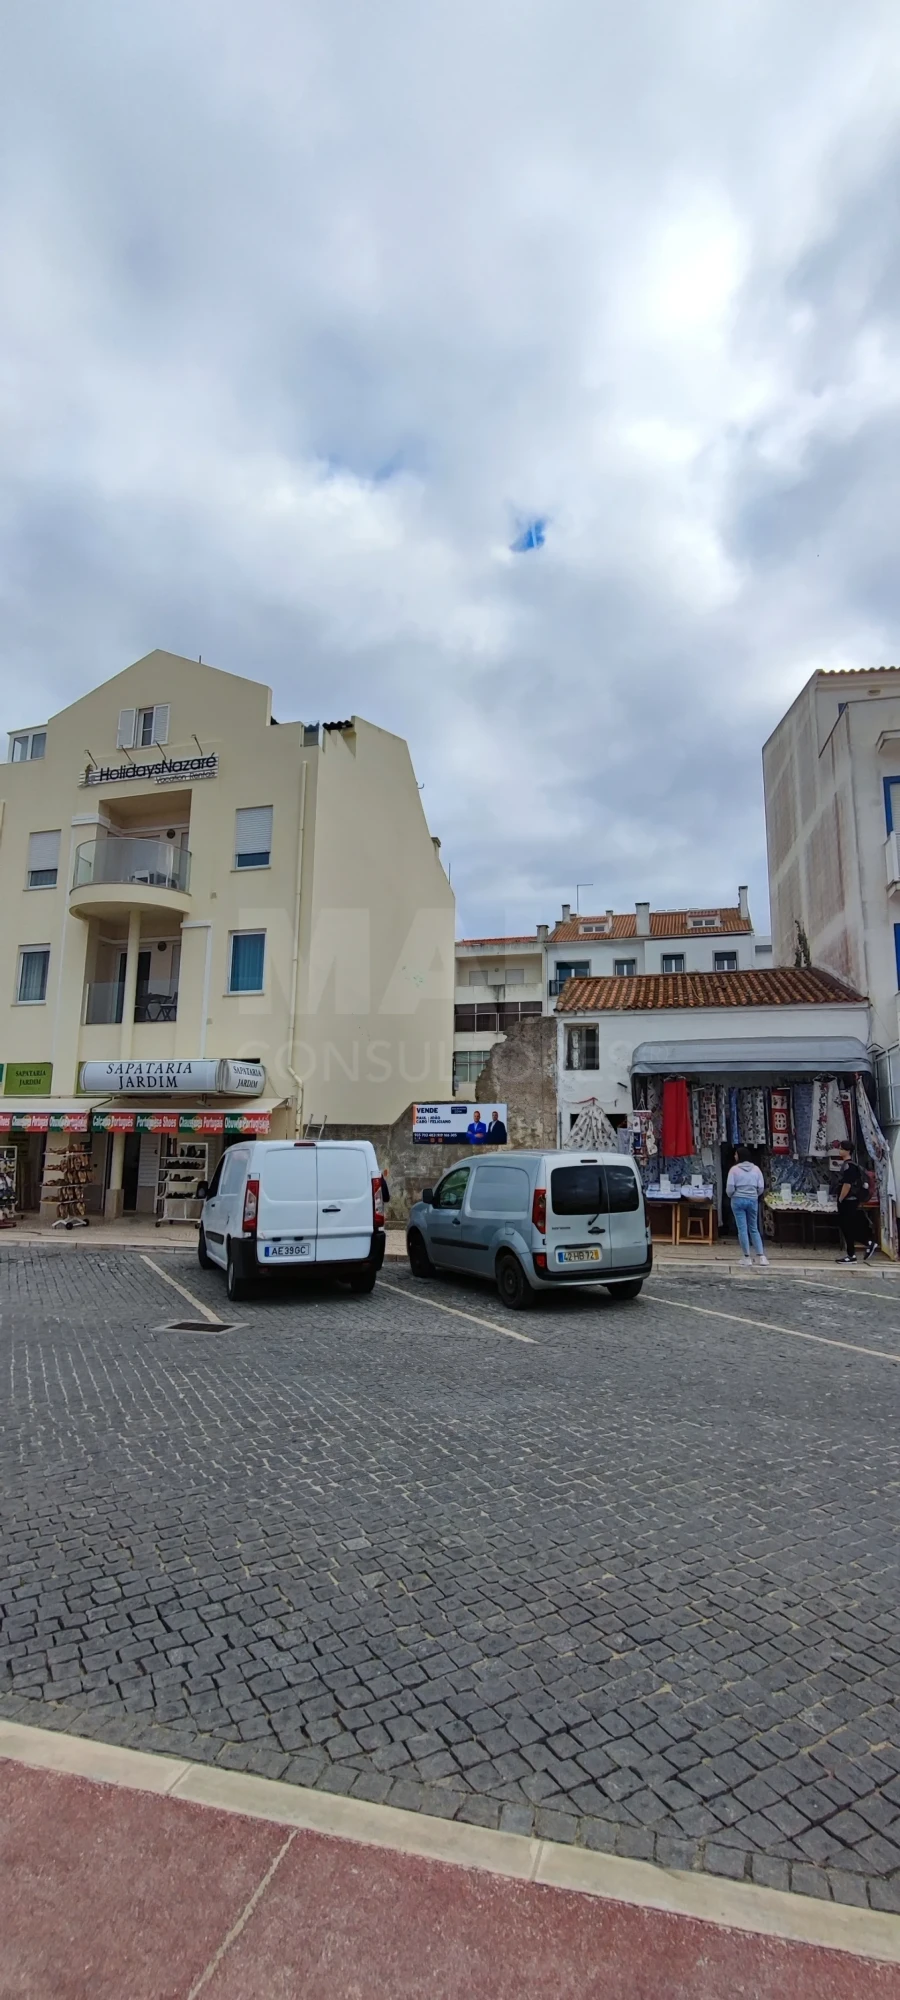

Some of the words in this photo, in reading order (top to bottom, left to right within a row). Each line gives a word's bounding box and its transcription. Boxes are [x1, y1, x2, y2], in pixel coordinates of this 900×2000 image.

[106, 1063, 192, 1075] SAPATARIA
[233, 1065, 262, 1077] SAPATARIA
[19, 1079, 42, 1088] JARDIM
[118, 1076, 178, 1090] JARDIM
[236, 1078, 259, 1089] JARDIM
[163, 1116, 176, 1127] Shoes
